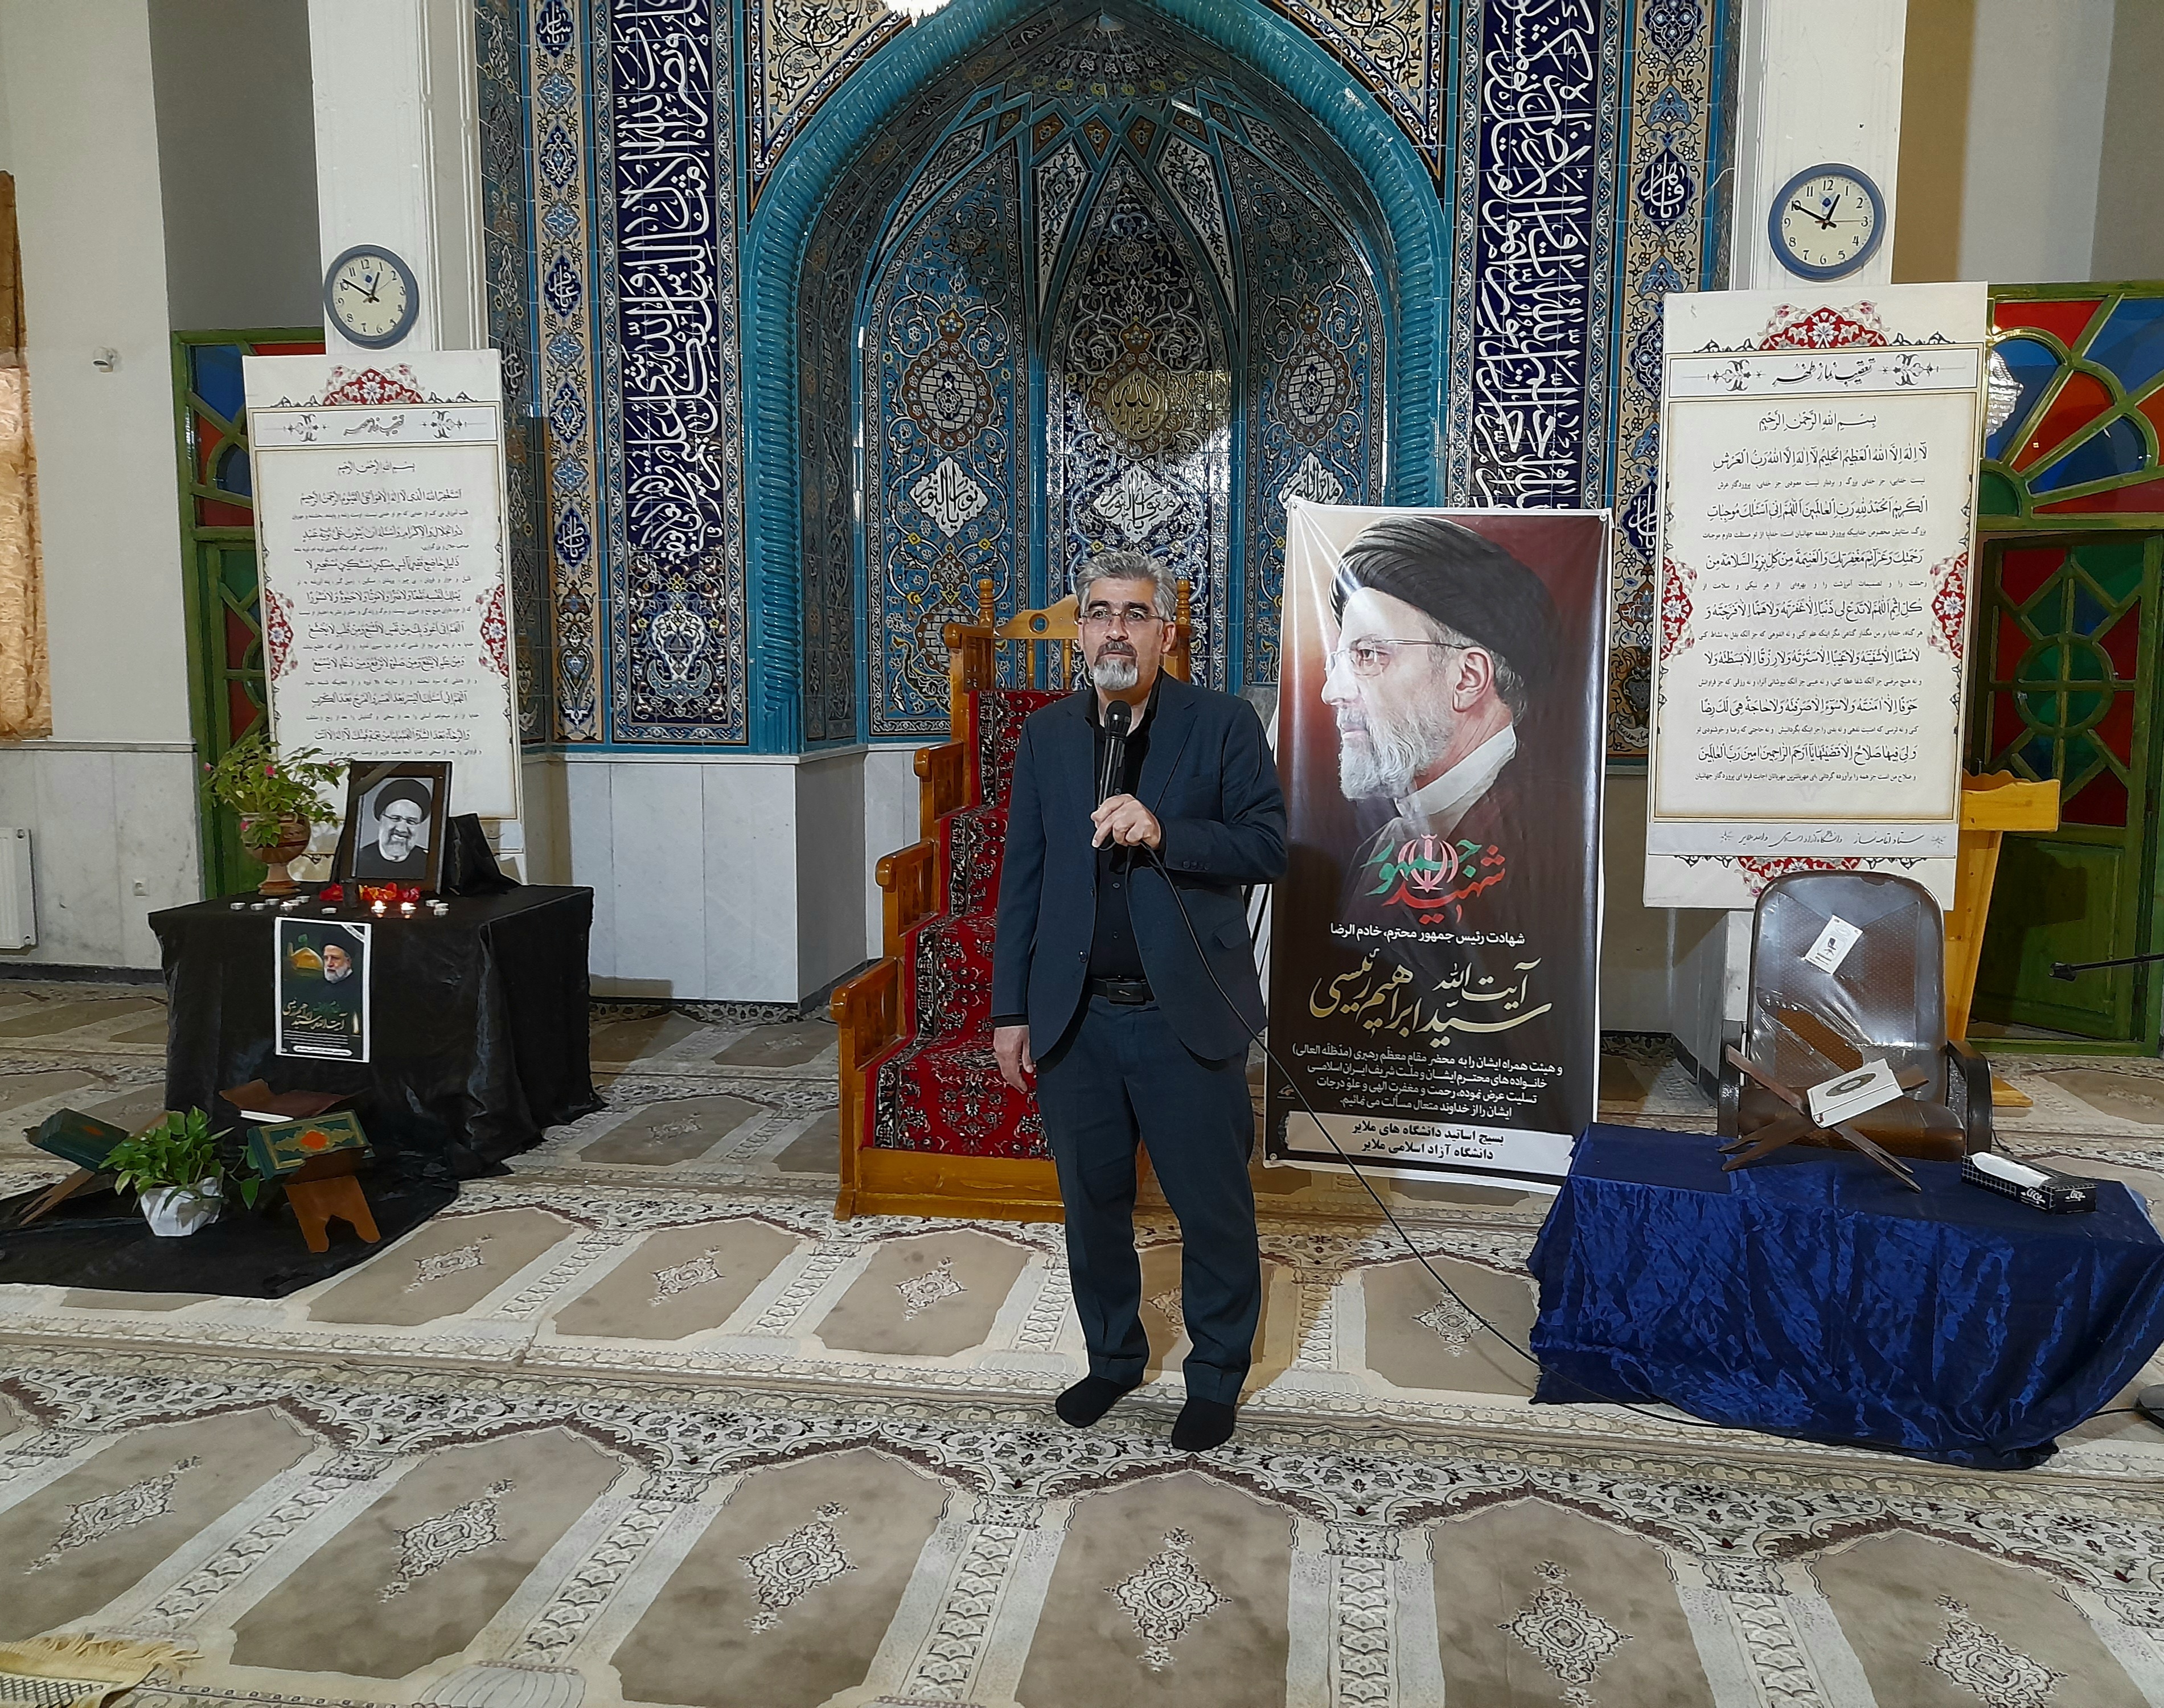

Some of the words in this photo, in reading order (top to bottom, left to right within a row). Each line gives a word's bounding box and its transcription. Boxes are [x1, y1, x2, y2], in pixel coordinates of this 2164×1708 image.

[1806, 186, 1813, 196] 11
[1823, 180, 1834, 191] 12
[1845, 186, 1849, 196] 1
[1856, 197, 1863, 208] 2
[1784, 217, 1791, 228] 9
[1861, 216, 1869, 227] 3
[1789, 237, 1796, 247] 8
[1852, 236, 1859, 246] 4
[1803, 250, 1809, 260] 7
[1820, 253, 1826, 264] 6
[1838, 250, 1846, 260] 5
[361, 259, 369, 269] 12
[379, 262, 383, 272] 1
[348, 266, 356, 277] 11
[391, 270, 397, 281] 2
[400, 286, 405, 295] 3
[346, 314, 354, 322] 8
[362, 323, 366, 332] 7
[376, 324, 383, 334] 6
[1817, 361, 1837, 381] نماز
[1835, 358, 1876, 386] تعقیب
[1111, 373, 1160, 412] الله
[1360, 837, 1483, 896] جمهور
[1381, 844, 1506, 925] شهید
[1330, 922, 1356, 936] الرضا
[1357, 925, 1382, 942] خادم
[1383, 927, 1417, 943] محترم،
[1418, 930, 1455, 943] جمهور
[1456, 931, 1485, 945] رئیس
[1486, 931, 1525, 947] شهادت
[1431, 962, 1472, 991] الله
[1308, 948, 1381, 1020] رئیسی
[1461, 958, 1542, 1010] آیت
[1355, 964, 1423, 1039] ابراهیم
[1354, 1050, 1378, 1061] رهبری
[1407, 1051, 1427, 1066] مقام
[1428, 1054, 1455, 1066] محضر
[1307, 1061, 1342, 1073] اسلامی
[1458, 1057, 1467, 1069] به
[1468, 1056, 1475, 1068] را
[1476, 1056, 1501, 1071] ایشان
[1502, 1059, 1527, 1072] همراه
[1529, 1061, 1555, 1075] هیئت
[1342, 1062, 1368, 1076] ایران
[1369, 1064, 1395, 1078] شریف
[1556, 1066, 1563, 1076] و
[1419, 1071, 1426, 1080] و
[1426, 1069, 1456, 1083] ایشان
[1457, 1073, 1490, 1086] محترم
[1490, 1074, 1509, 1086] های
[1317, 1077, 1345, 1090] درجات
[1362, 1083, 1368, 1091] و
[1369, 1081, 1387, 1093] الهی
[1389, 1082, 1419, 1094] مغفرت
[1510, 1077, 1548, 1089] خانواده
[1420, 1086, 1426, 1096] و
[1427, 1086, 1456, 1098] رحمت
[1483, 1091, 1505, 1102] عرض
[1366, 1099, 1380, 1108] می
[1381, 1095, 1412, 1108] مسألت
[1413, 1099, 1439, 1111] متعال
[1506, 1093, 1537, 1105] تسلیت
[1440, 1103, 1470, 1115] خداوند
[1470, 1104, 1480, 1116] از
[1480, 1105, 1485, 1117] را
[1487, 1105, 1512, 1120] ایشان
[1352, 1120, 1377, 1134] ملایر
[1379, 1123, 1400, 1136] های
[1402, 1124, 1442, 1138] دانشگاه
[1444, 1128, 1476, 1142] اساتید
[1479, 1134, 1504, 1146] بسیج
[1361, 1138, 1385, 1152] ملایر
[1388, 1140, 1424, 1155] اسلامی
[1427, 1143, 1451, 1159] آزاد
[1454, 1146, 1493, 1160] دانشگاه
